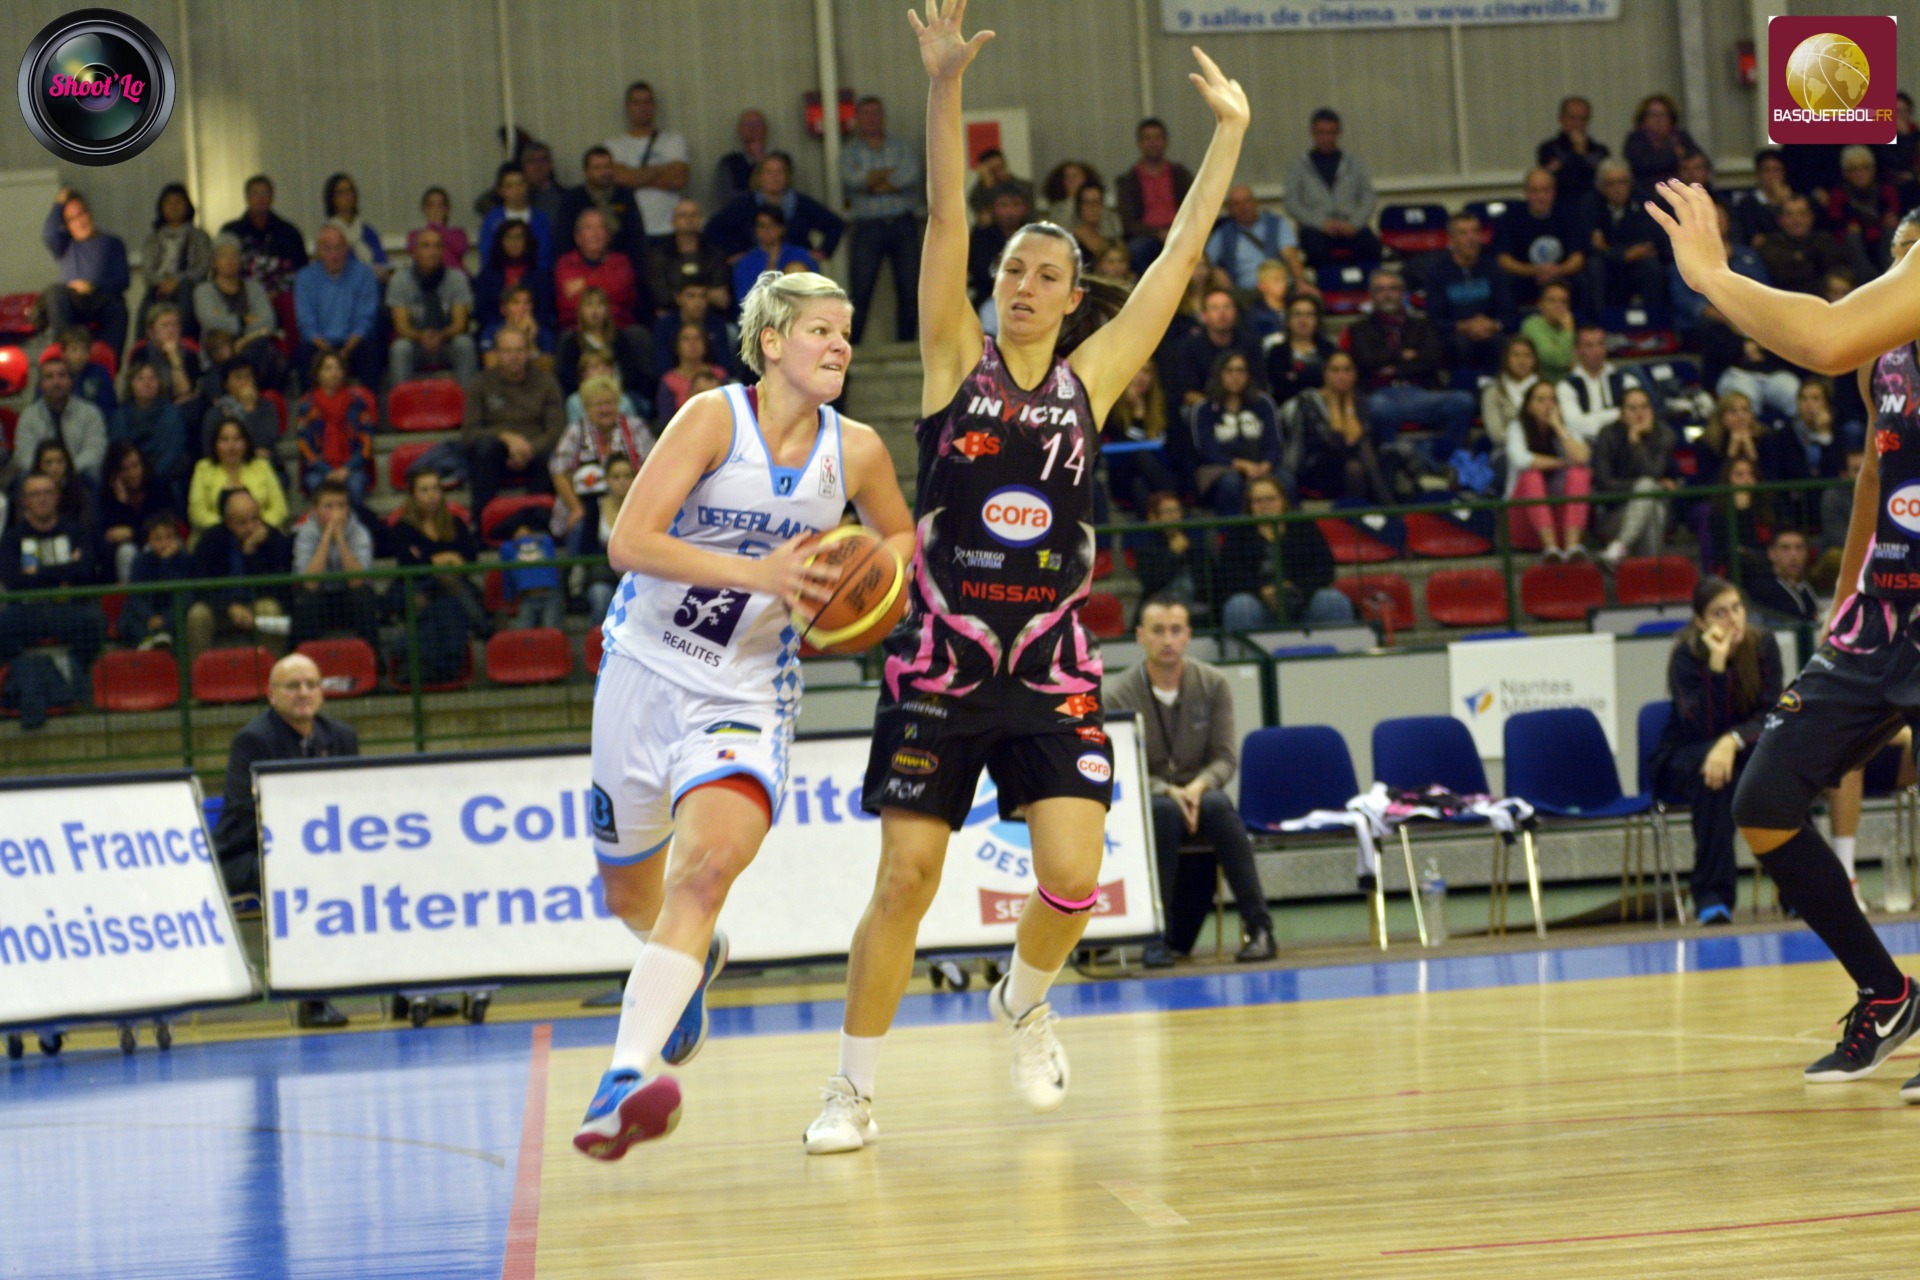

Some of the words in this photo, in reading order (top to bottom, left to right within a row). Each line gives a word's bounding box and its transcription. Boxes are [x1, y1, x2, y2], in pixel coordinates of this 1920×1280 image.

[1199, 7, 1265, 27] salles
[1271, 7, 1300, 25] de
[967, 388, 1079, 426] INVICTA
[1040, 432, 1085, 486] 14
[984, 503, 1049, 528] cora
[965, 549, 1005, 562] ALTEREGO
[961, 580, 1057, 603] NISSAN
[662, 631, 723, 668] REALITES
[1079, 760, 1110, 777] cora
[301, 804, 432, 855] des
[0, 838, 55, 877] en
[61, 821, 212, 872] France
[976, 841, 1030, 877] DES
